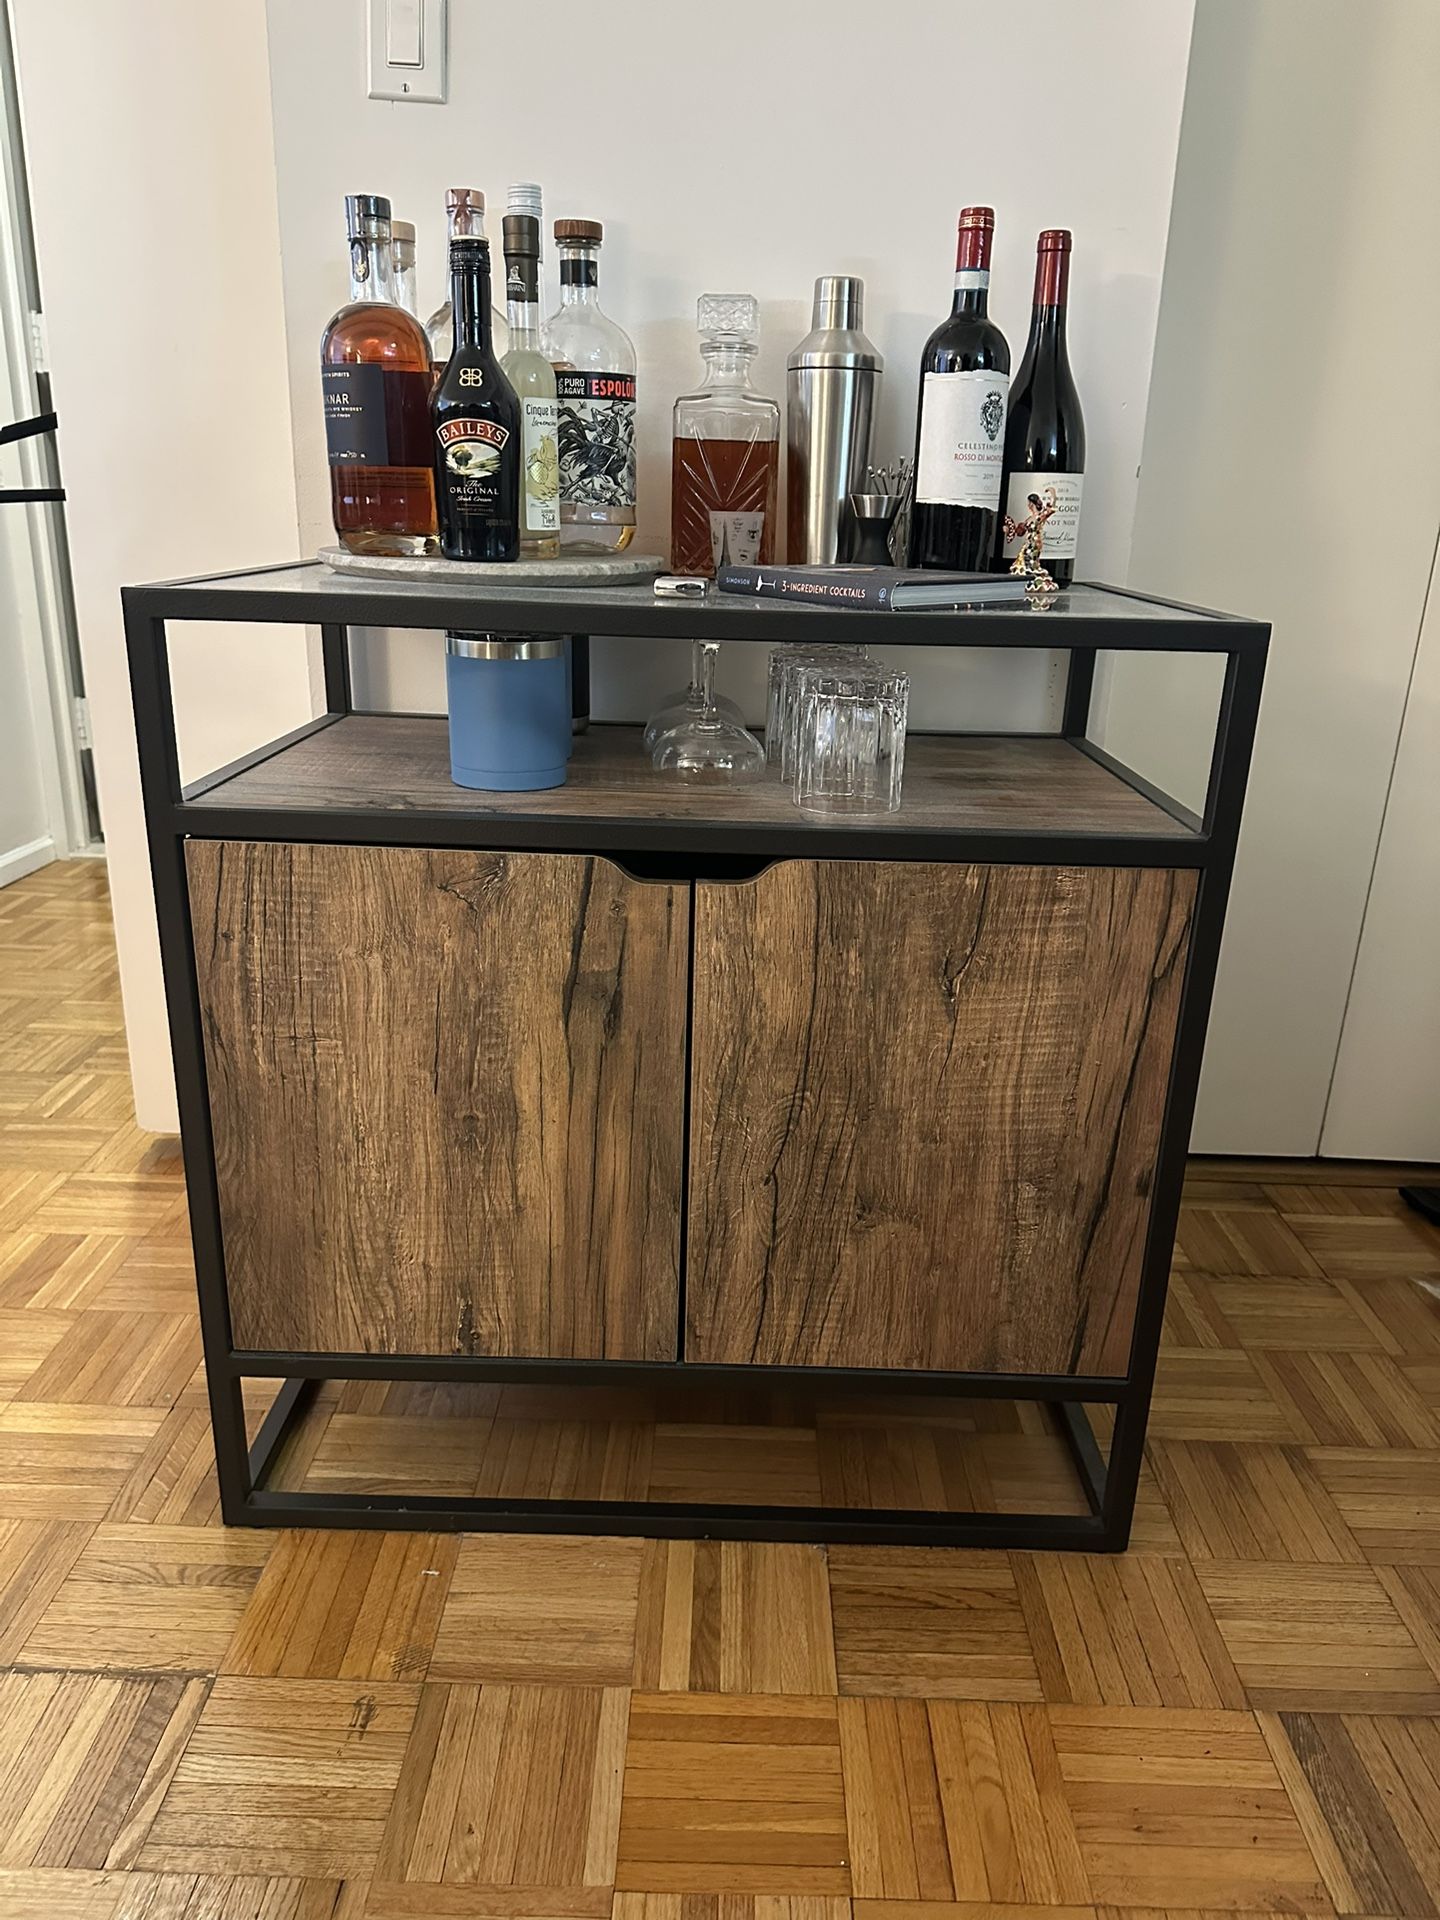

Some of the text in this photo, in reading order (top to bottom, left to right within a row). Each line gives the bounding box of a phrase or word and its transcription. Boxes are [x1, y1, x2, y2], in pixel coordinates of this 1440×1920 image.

[564, 378, 586, 387] PURO
[564, 387, 586, 395] AGAVE
[525, 403, 549, 416] Cinque
[440, 422, 503, 442] BAILEYS
[954, 453, 977, 461] ROSSO
[977, 454, 985, 462] DI
[449, 486, 500, 496] ORIGINAL
[725, 576, 750, 585] SIMONSON
[781, 580, 828, 595] 3-INGREDIENT
[829, 586, 866, 599] COCKTAILS
